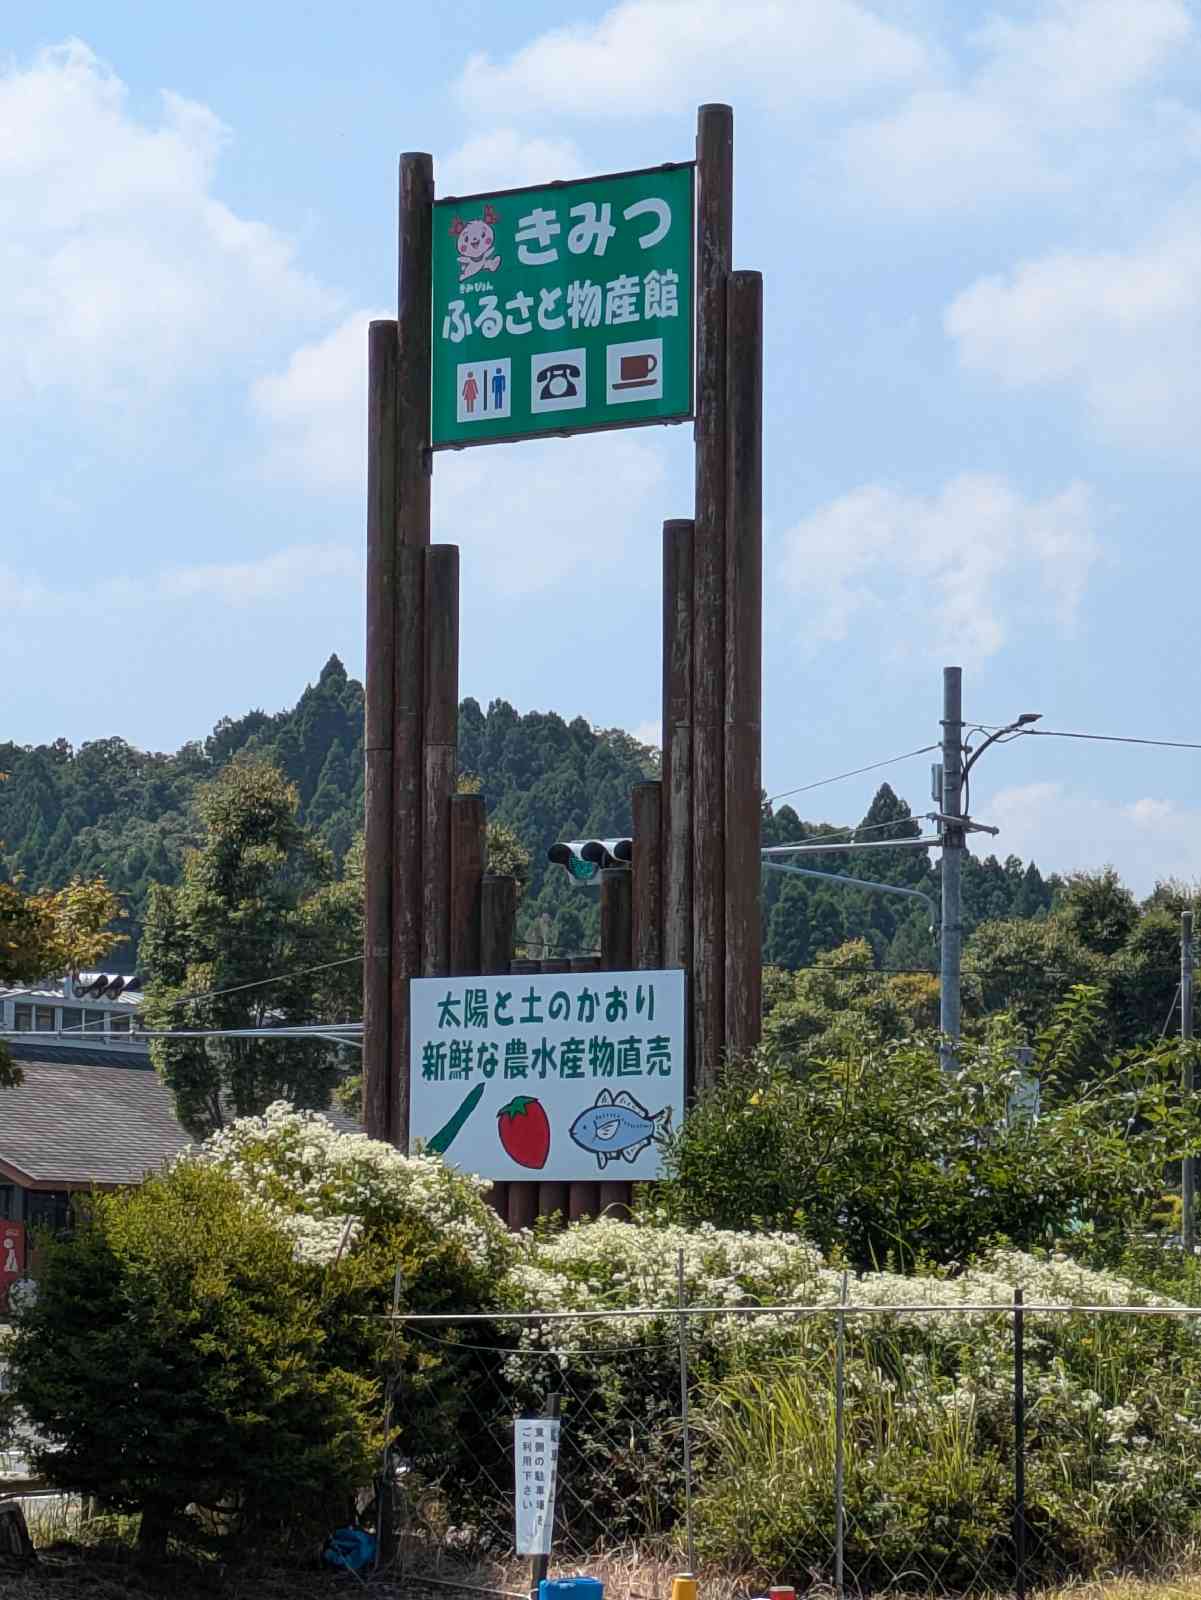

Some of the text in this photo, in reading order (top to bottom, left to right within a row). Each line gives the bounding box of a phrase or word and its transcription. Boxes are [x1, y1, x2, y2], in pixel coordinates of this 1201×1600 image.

[515, 198, 672, 266] きみつ
[442, 268, 679, 343] ふるさと物産館
[437, 984, 655, 1029] 太陽と土のかおり
[422, 1035, 672, 1081] 新鮮な農水産物直売
